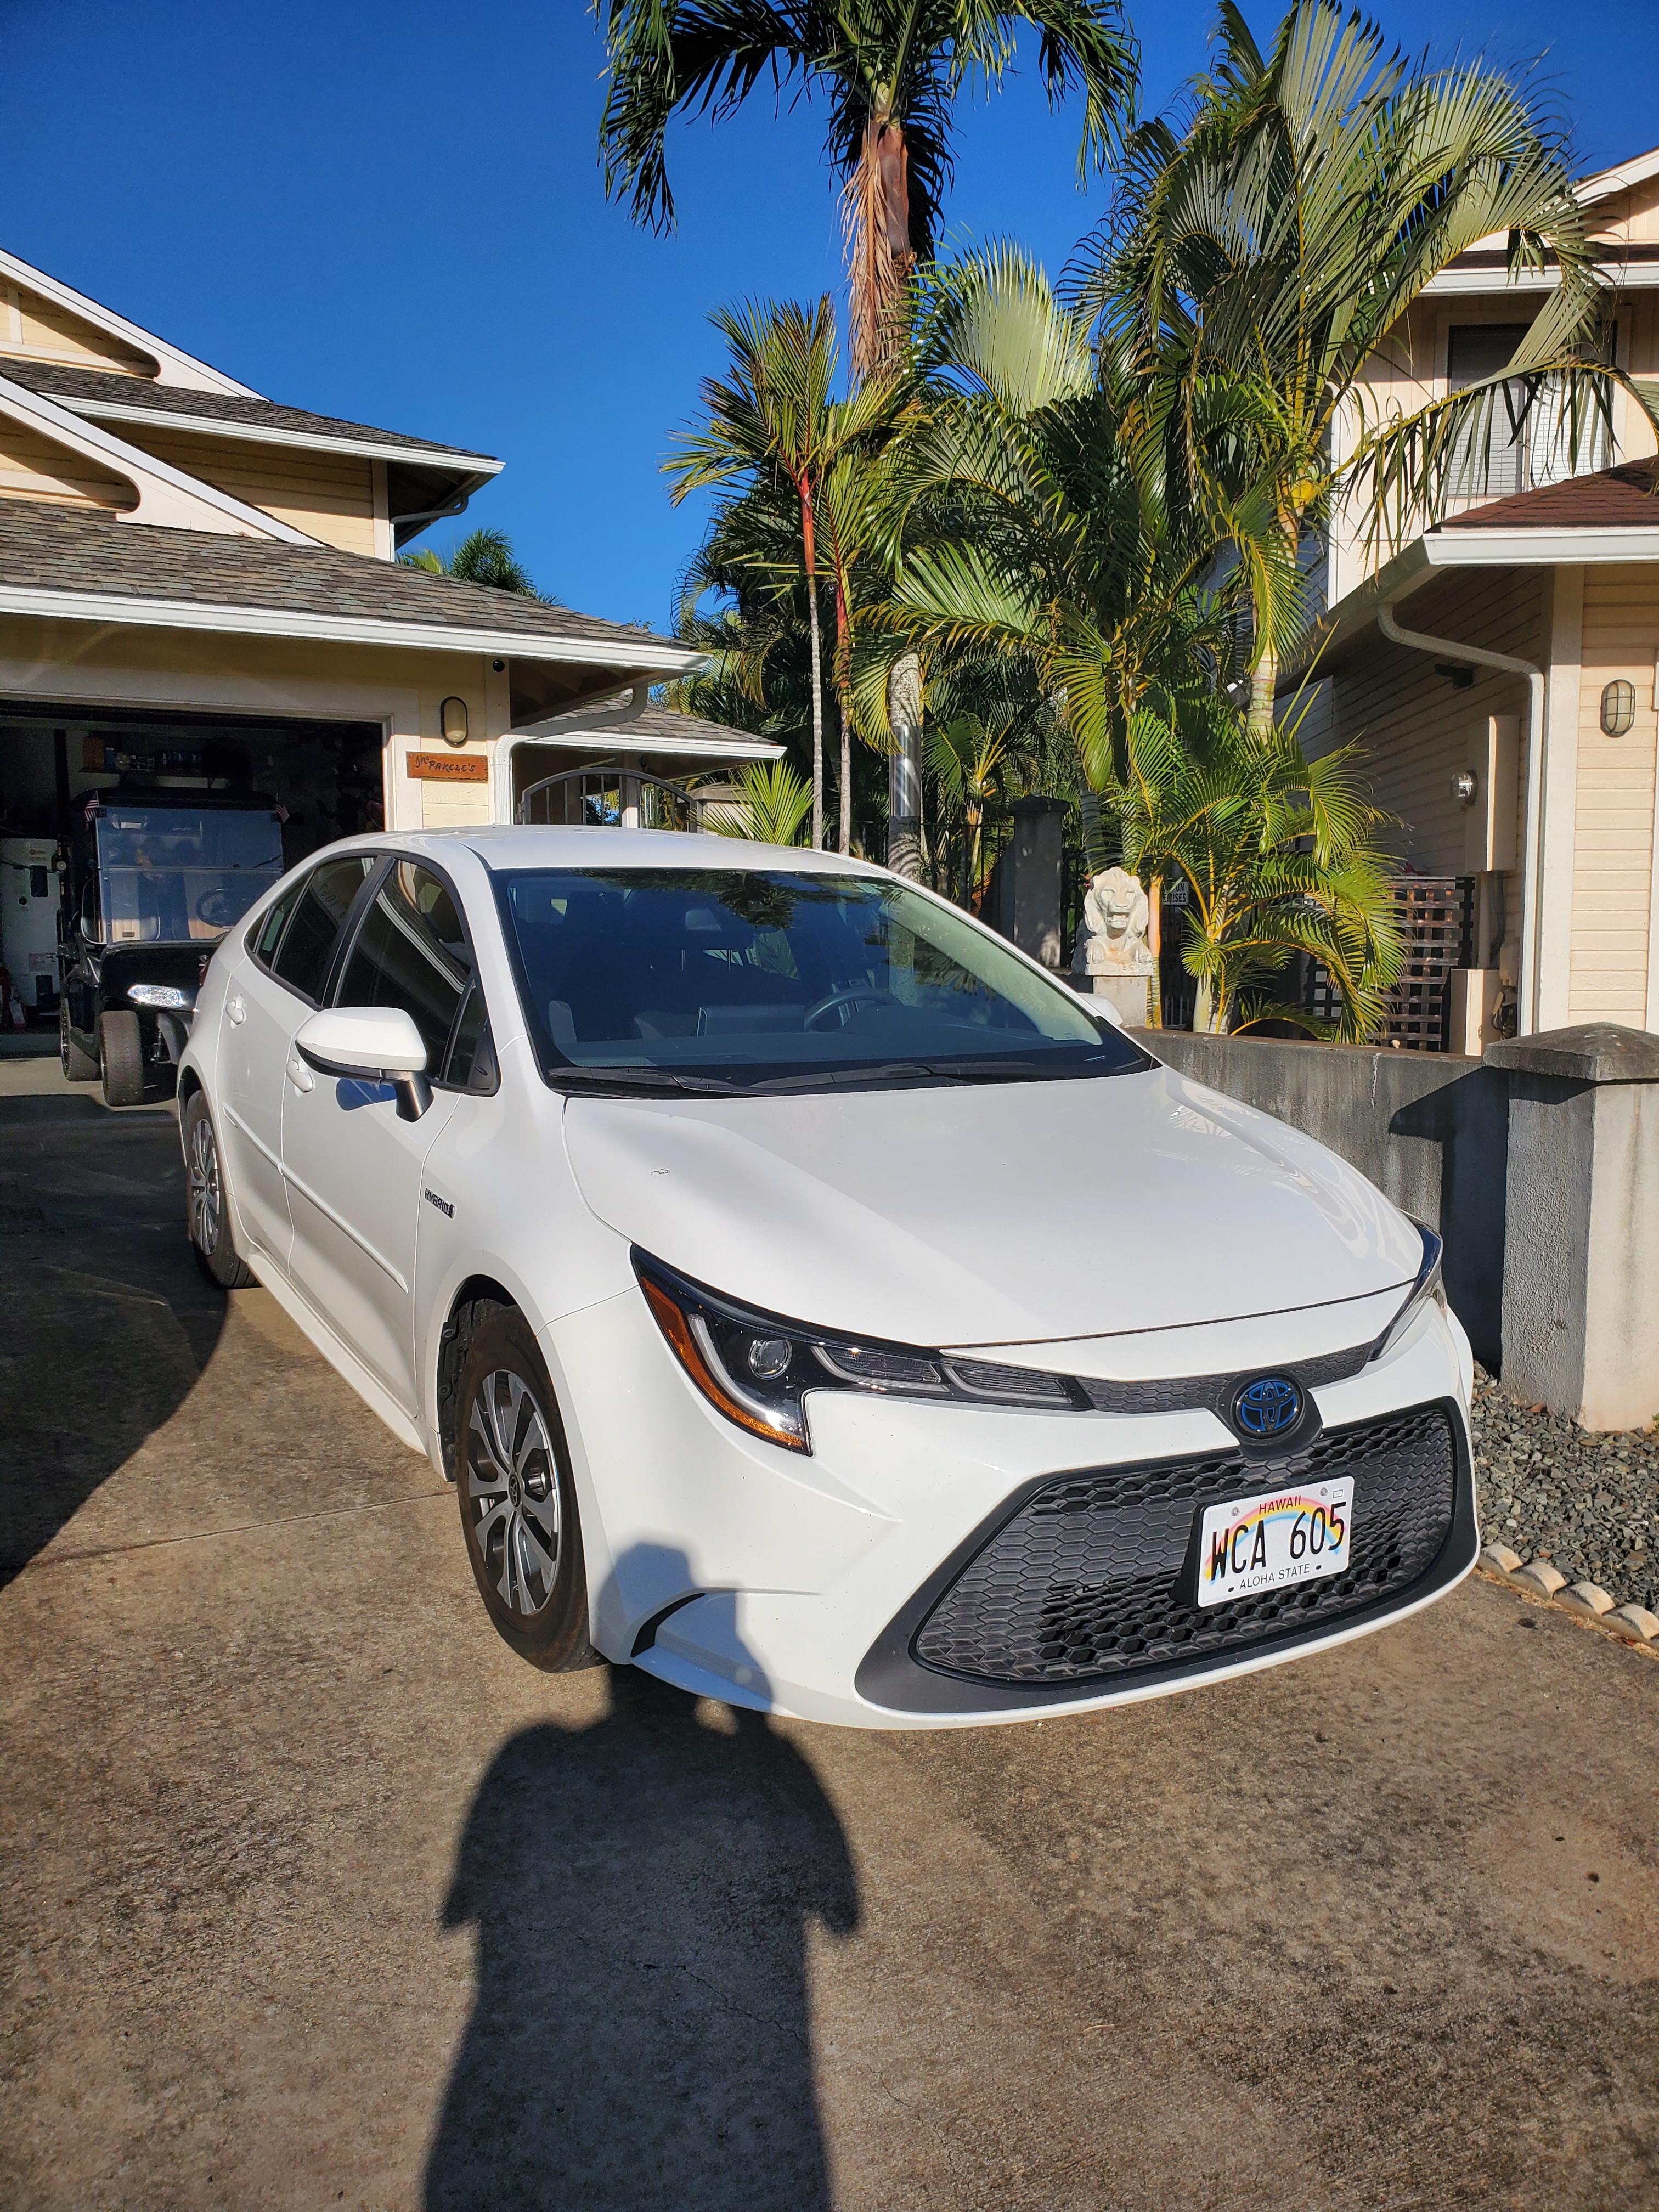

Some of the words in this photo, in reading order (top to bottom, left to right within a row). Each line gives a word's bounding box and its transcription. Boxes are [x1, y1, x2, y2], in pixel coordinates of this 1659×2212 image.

[424, 1188, 450, 1216] HYBRID
[1259, 1495, 1302, 1515] HAWAII
[1210, 1520, 1267, 1581] WCA
[1289, 1502, 1346, 1559] 605
[1239, 1573, 1275, 1589] ALOHA
[1278, 1564, 1310, 1580] STATE
